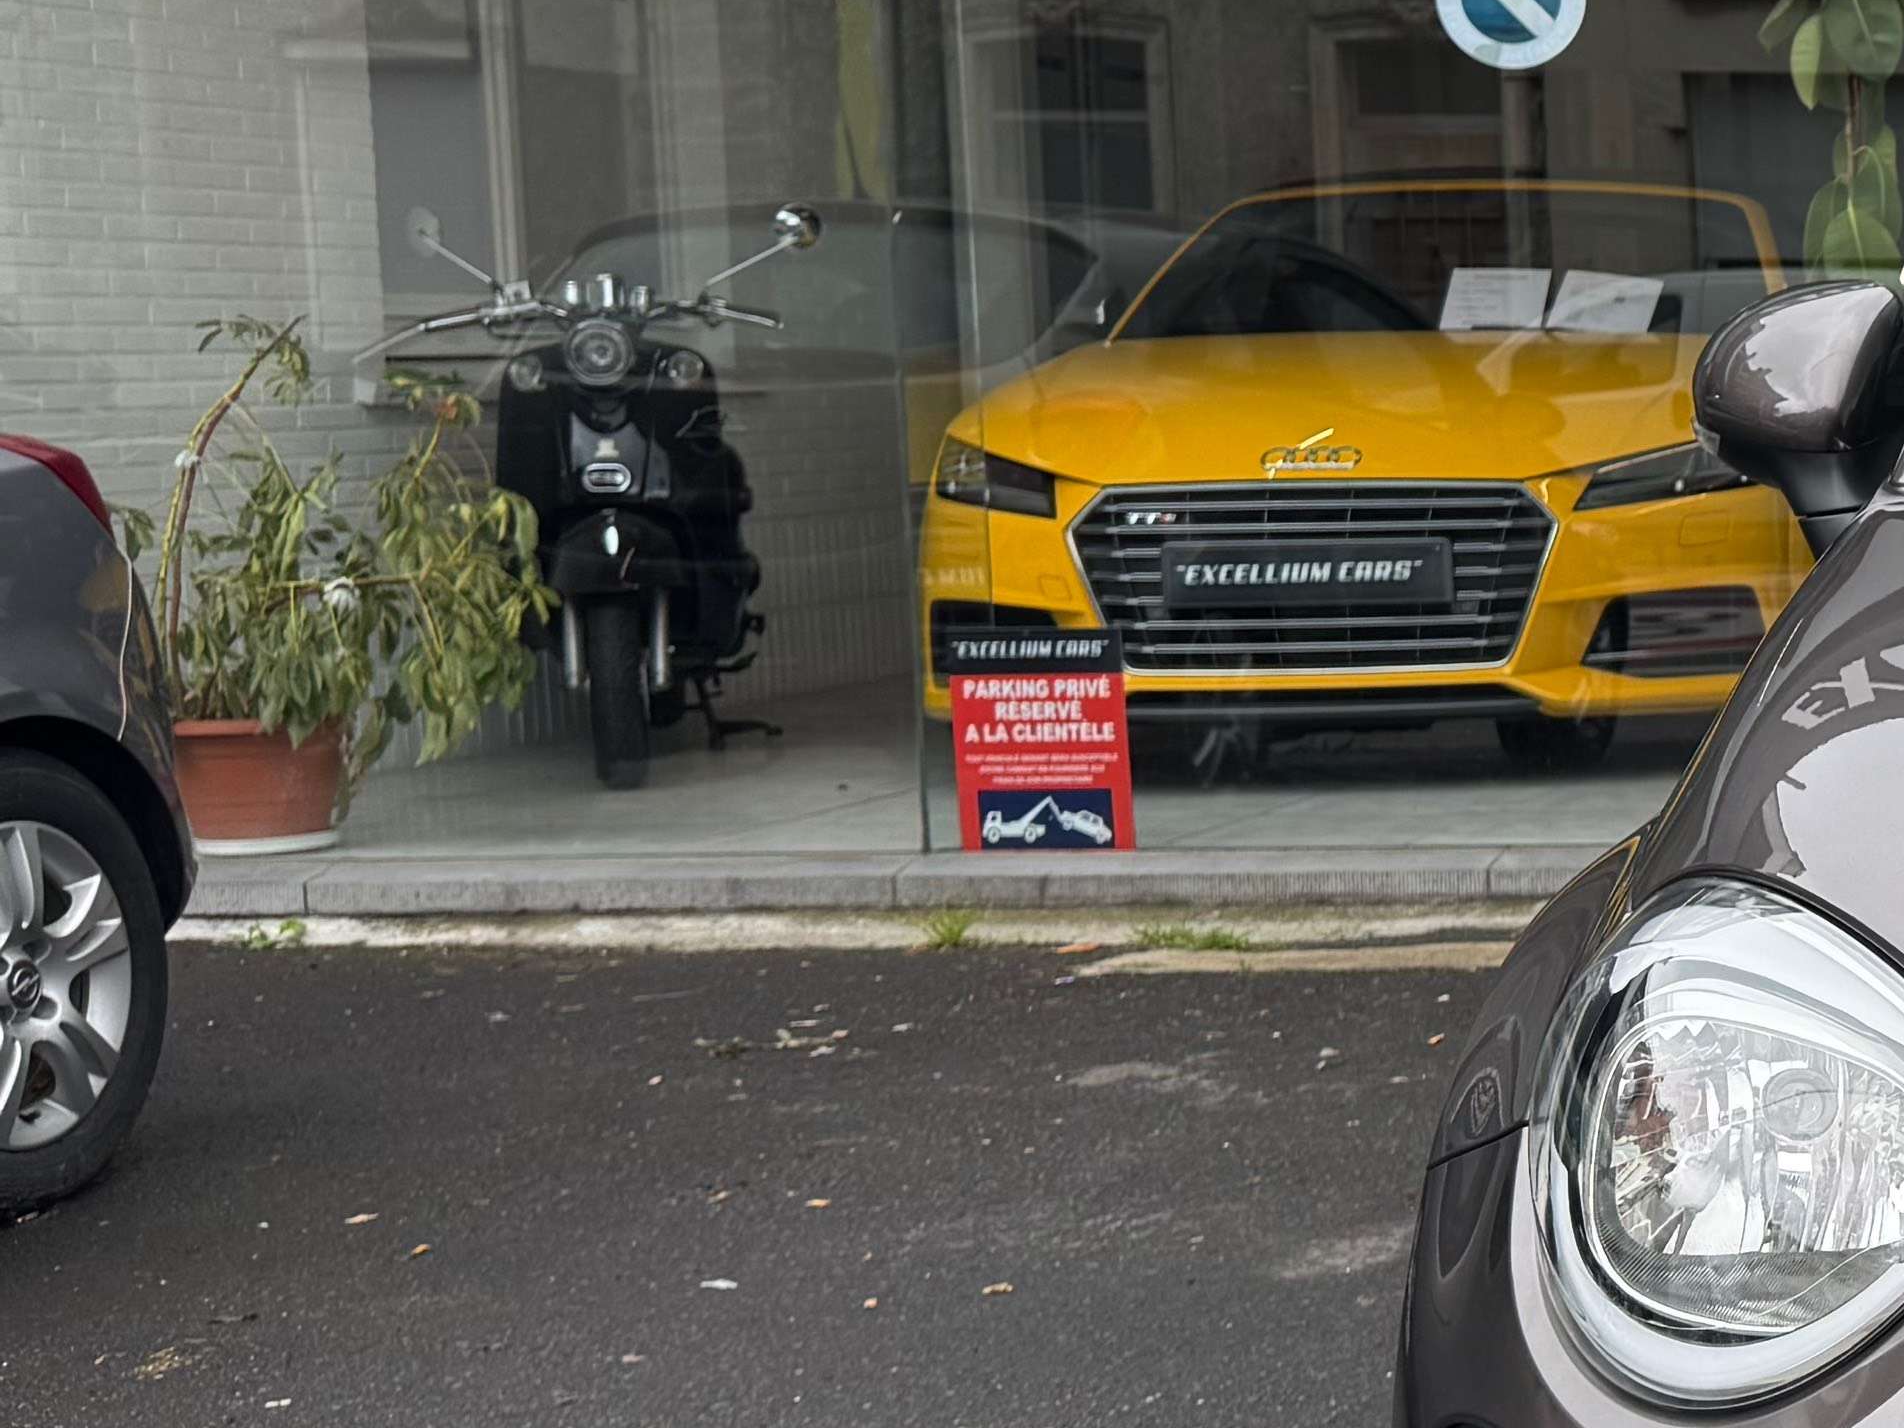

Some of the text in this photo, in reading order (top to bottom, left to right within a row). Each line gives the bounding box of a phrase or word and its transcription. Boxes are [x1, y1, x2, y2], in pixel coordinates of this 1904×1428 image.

[1184, 559, 1413, 586] EXCELLIUM CARS
[957, 640, 1050, 659] EXCELLIUM
[963, 674, 1111, 699] PARKING PRIVÉ
[964, 719, 1115, 743] A LA CLIENTÈLE
